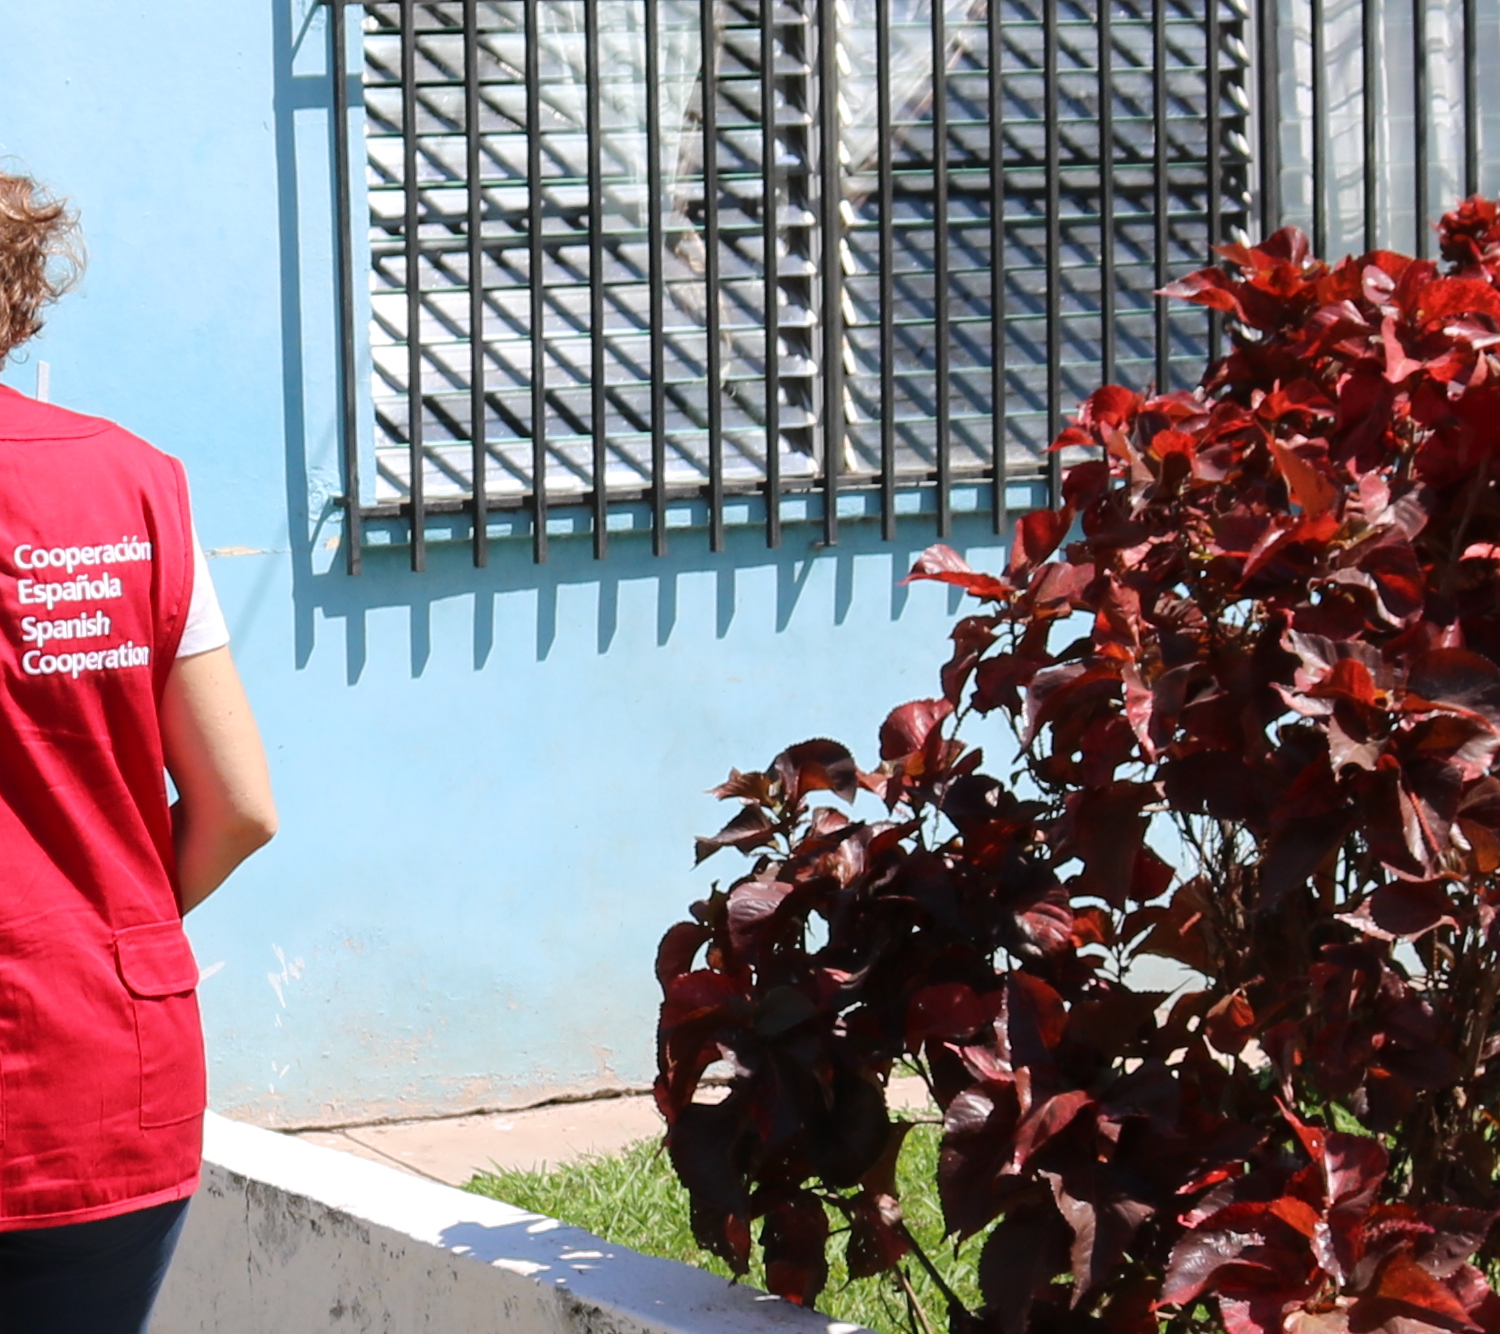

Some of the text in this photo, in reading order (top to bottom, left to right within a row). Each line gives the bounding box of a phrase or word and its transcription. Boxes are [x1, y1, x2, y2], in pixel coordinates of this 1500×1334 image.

[13, 535, 152, 573] Cooperación
[17, 572, 122, 610] Española
[20, 610, 112, 647] Spanish
[22, 640, 150, 679] Cooperation
